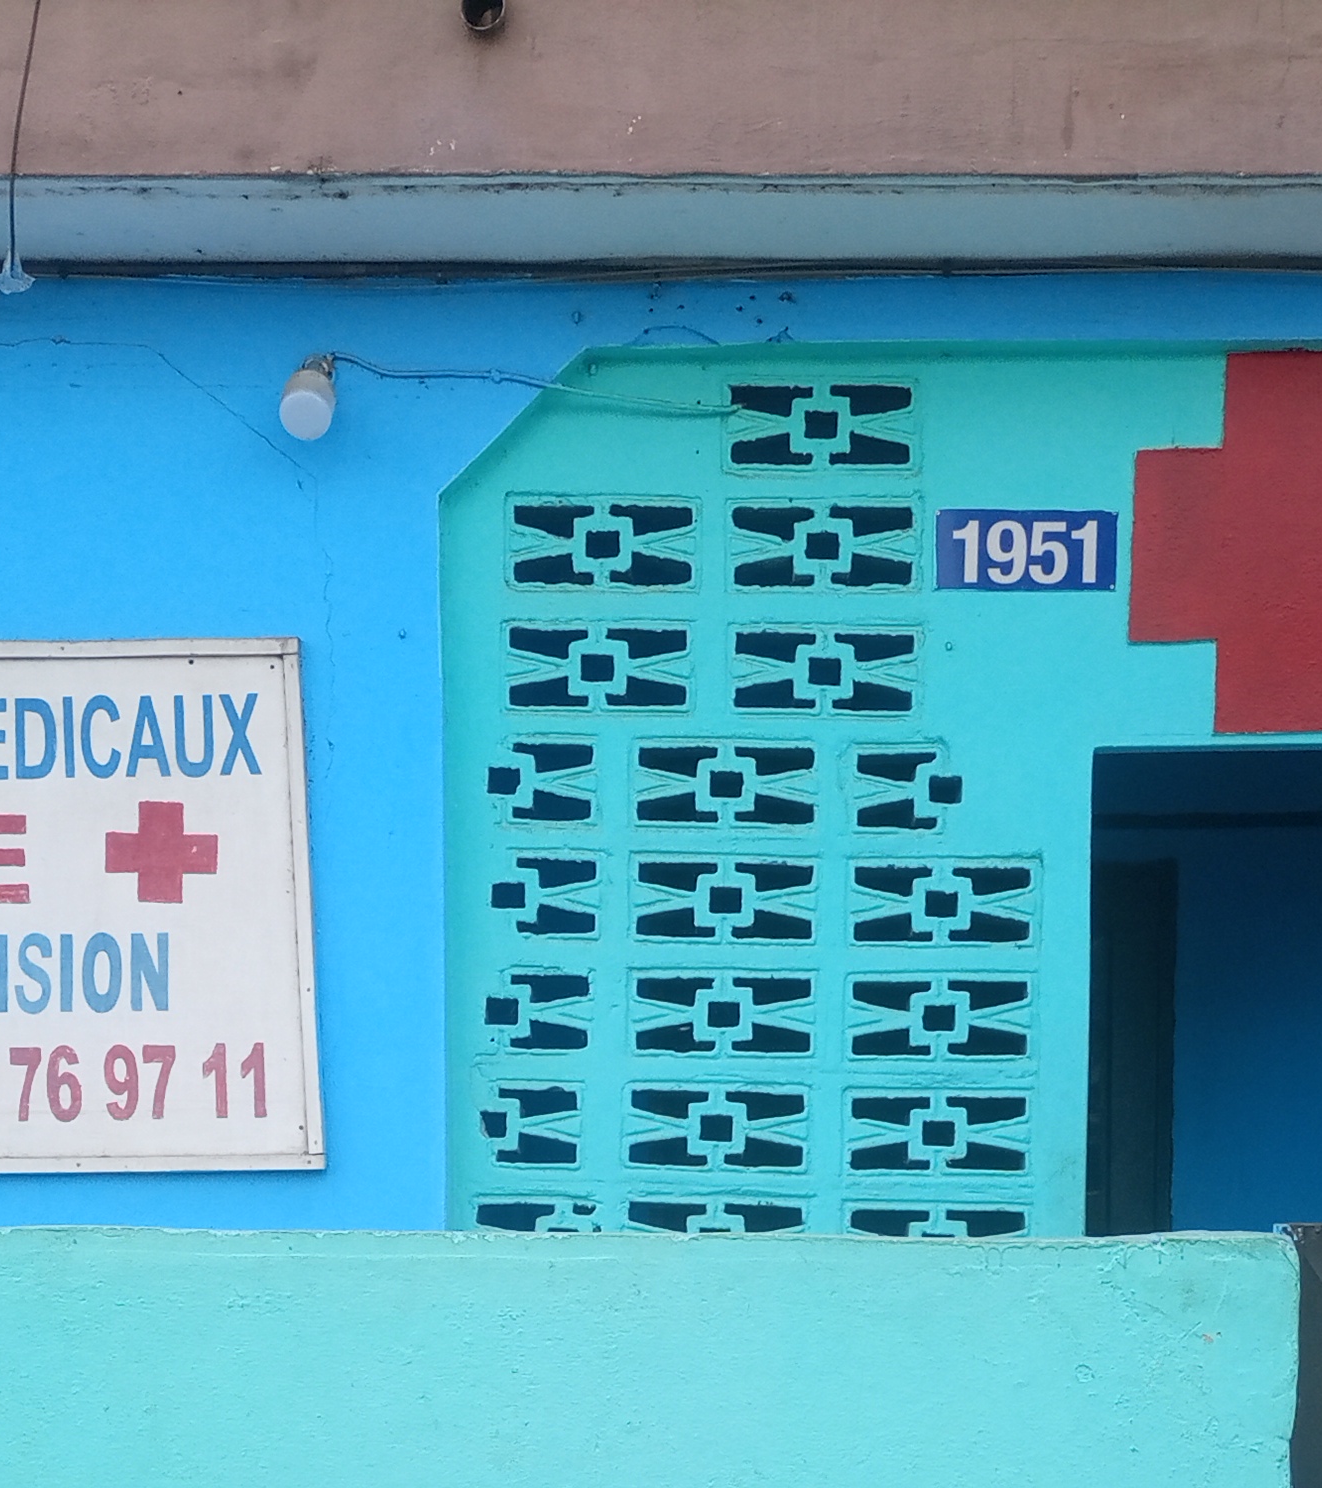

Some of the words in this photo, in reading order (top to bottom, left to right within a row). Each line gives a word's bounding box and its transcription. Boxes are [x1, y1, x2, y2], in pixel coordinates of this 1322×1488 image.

[952, 520, 1098, 585] 1951
[9, 1045, 83, 1123] 76
[103, 1044, 177, 1121] 97
[202, 1042, 268, 1119] 11
